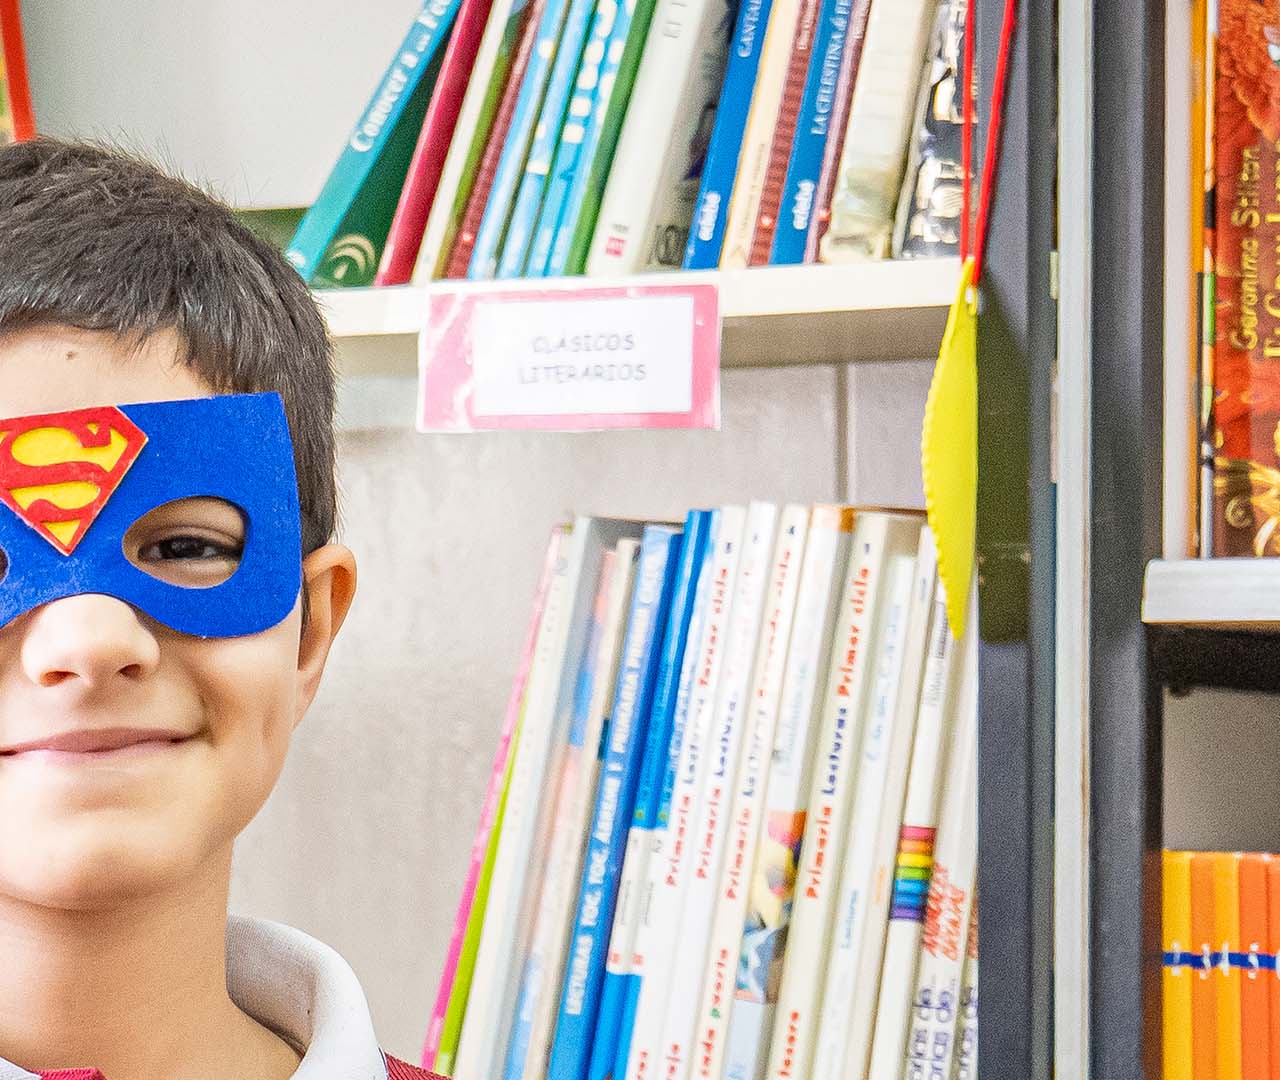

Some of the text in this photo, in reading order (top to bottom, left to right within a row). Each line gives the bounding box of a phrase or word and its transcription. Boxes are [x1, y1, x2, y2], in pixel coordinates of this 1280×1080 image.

[517, 361, 648, 385] LITERARIOS
[805, 804, 834, 901] Primaria
[821, 705, 849, 797] Lecturas
[836, 622, 861, 699] Primer
[849, 566, 870, 617] ciclo
[665, 795, 691, 887] Primaria
[695, 786, 723, 880] Primaria
[725, 807, 752, 902] Primaria
[699, 1026, 717, 1079] cada
[708, 946, 730, 1022] puerta
[776, 1009, 802, 1077] tesoro
